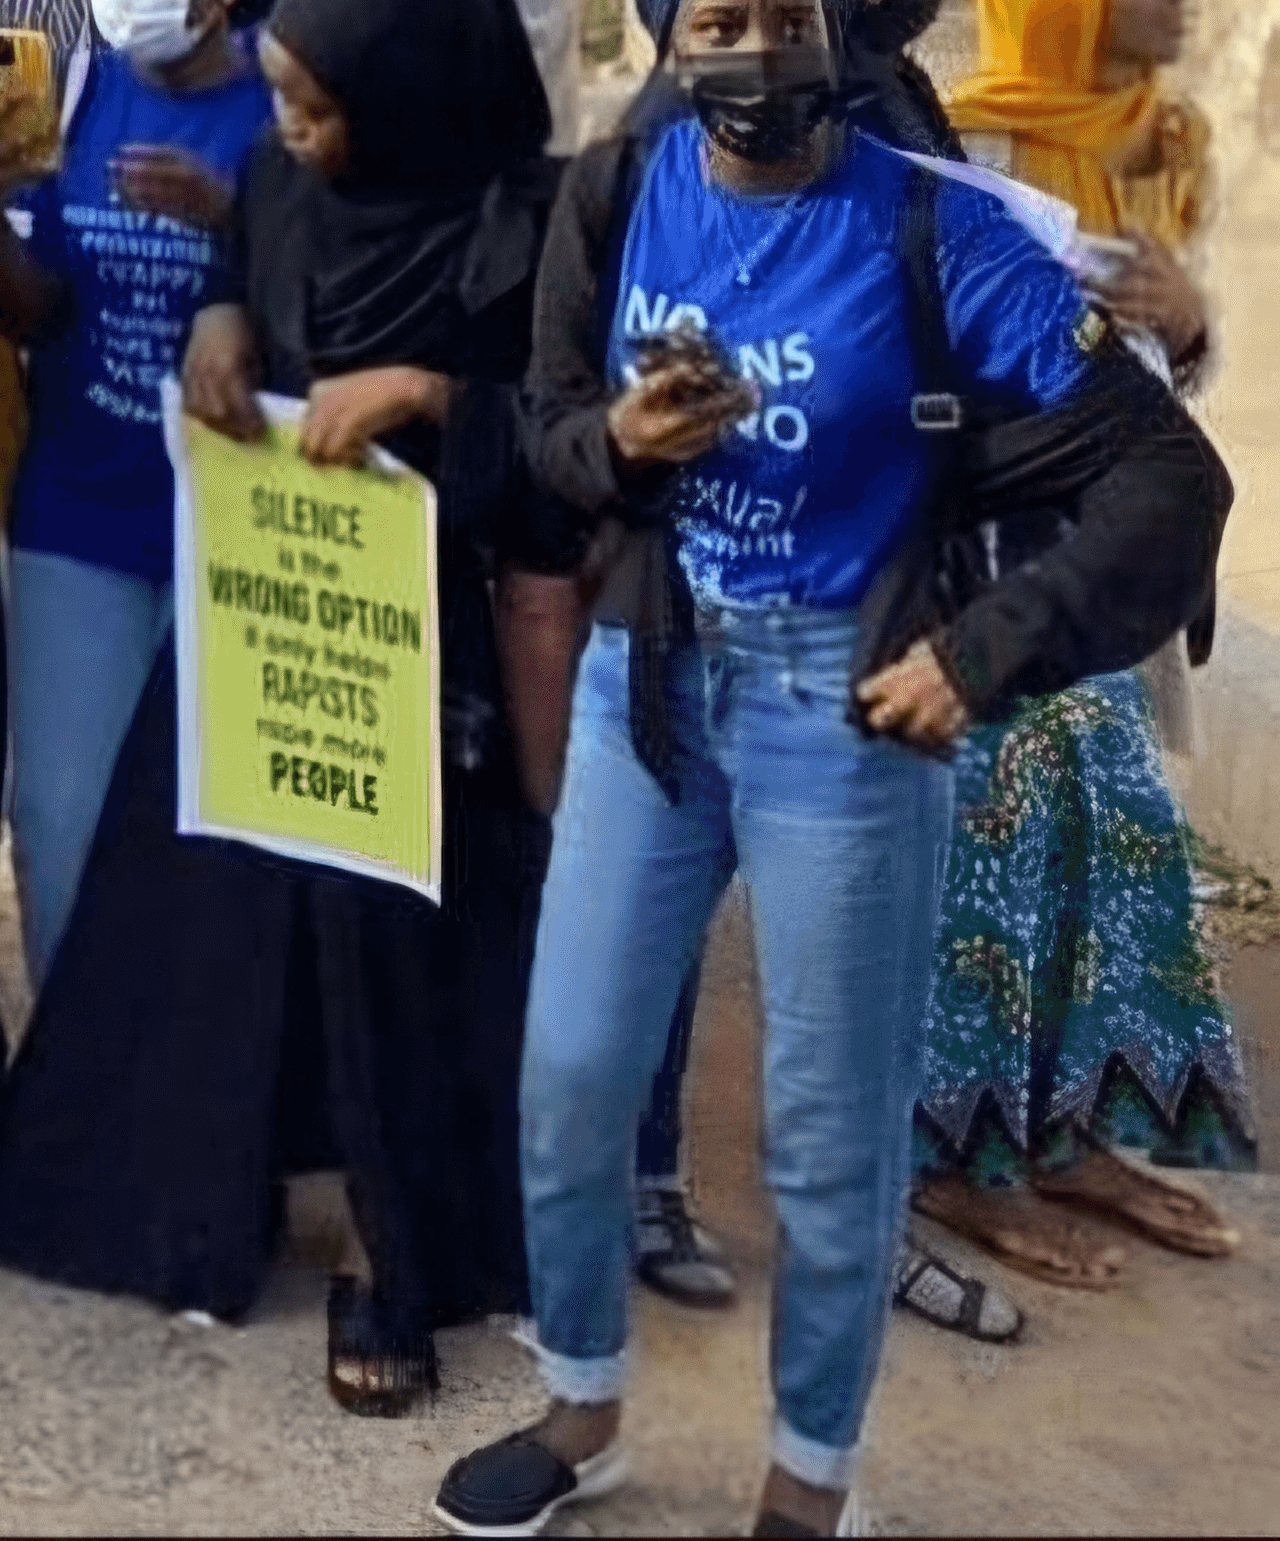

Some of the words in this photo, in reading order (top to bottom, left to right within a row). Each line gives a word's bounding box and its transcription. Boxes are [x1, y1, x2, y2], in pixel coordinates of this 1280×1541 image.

[250, 484, 365, 550] SILENCE
[207, 559, 311, 625] WRONG
[316, 588, 422, 654] OPTION
[262, 661, 380, 728] RAPISTS
[270, 751, 379, 816] PEOPLE
